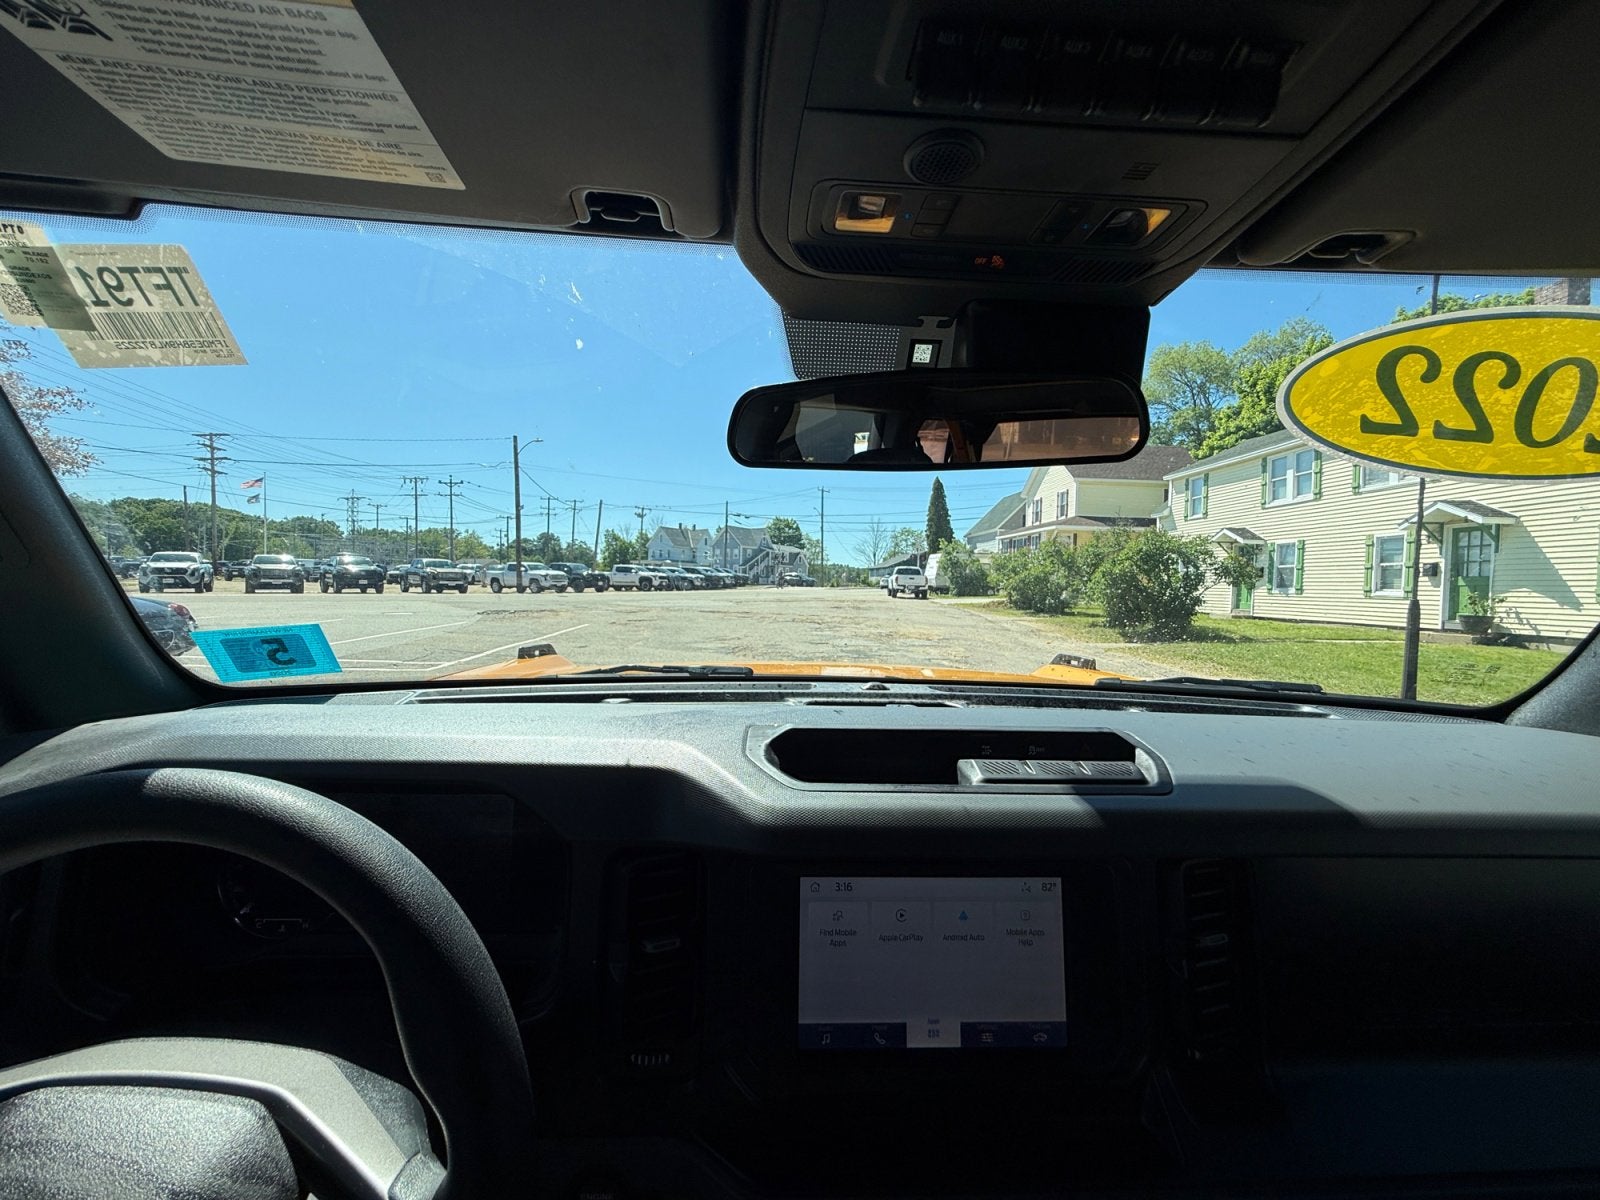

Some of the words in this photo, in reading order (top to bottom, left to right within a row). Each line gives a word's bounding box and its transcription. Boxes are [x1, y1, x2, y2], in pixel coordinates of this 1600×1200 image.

[255, 5, 284, 15] AIR
[284, 8, 328, 21] BAGS
[233, 29, 262, 37] place
[291, 25, 307, 33] by
[304, 27, 323, 35] the
[283, 45, 300, 53] the
[54, 54, 98, 66] MÊME
[95, 59, 139, 71] AVEC
[135, 64, 169, 74] DES
[165, 67, 206, 79] SACS
[204, 72, 293, 89] GONFLABLES
[293, 83, 399, 101] PERFECTIONNÉS
[205, 122, 235, 130] CON
[234, 125, 260, 133] LAS
[260, 128, 308, 138] NUEVAS
[309, 134, 356, 143] BOLSAS
[835, 881, 853, 893] 3:16
[820, 928, 834, 938] Find
[836, 928, 857, 938] Mobile
[879, 932, 898, 943] Apple
[900, 932, 924, 943] CarPlay
[942, 932, 966, 942] Android
[968, 932, 985, 942] Auto
[1005, 927, 1026, 938] Mobile
[1028, 927, 1044, 938] Apps
[830, 938, 847, 948] Apps
[1018, 937, 1033, 948] Help
